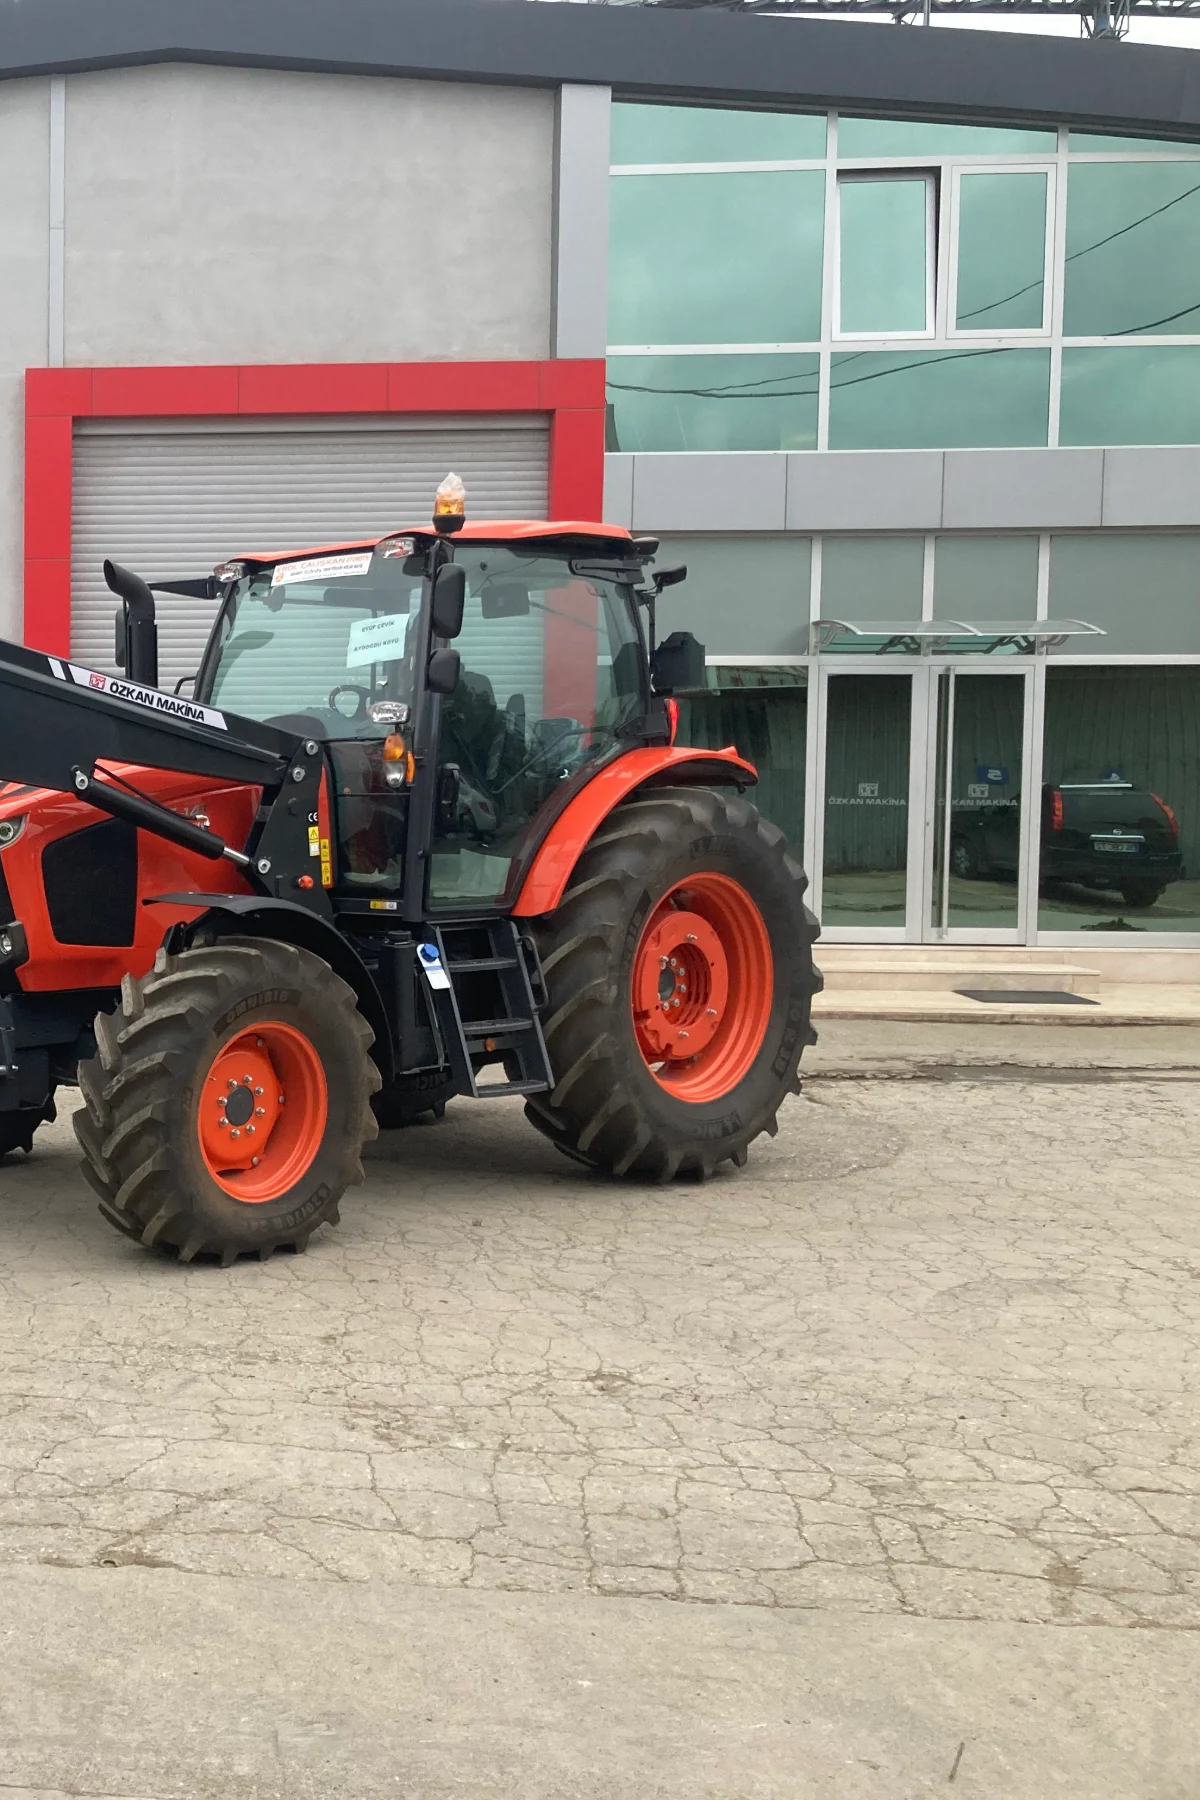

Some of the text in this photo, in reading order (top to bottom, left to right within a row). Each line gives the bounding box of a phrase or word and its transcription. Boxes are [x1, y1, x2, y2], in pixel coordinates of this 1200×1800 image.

[109, 680, 205, 721] ÖZKAN MAKİNA
[828, 796, 906, 806] ÖZKAN MAKİNA
[975, 798, 1018, 806] MAKİNA
